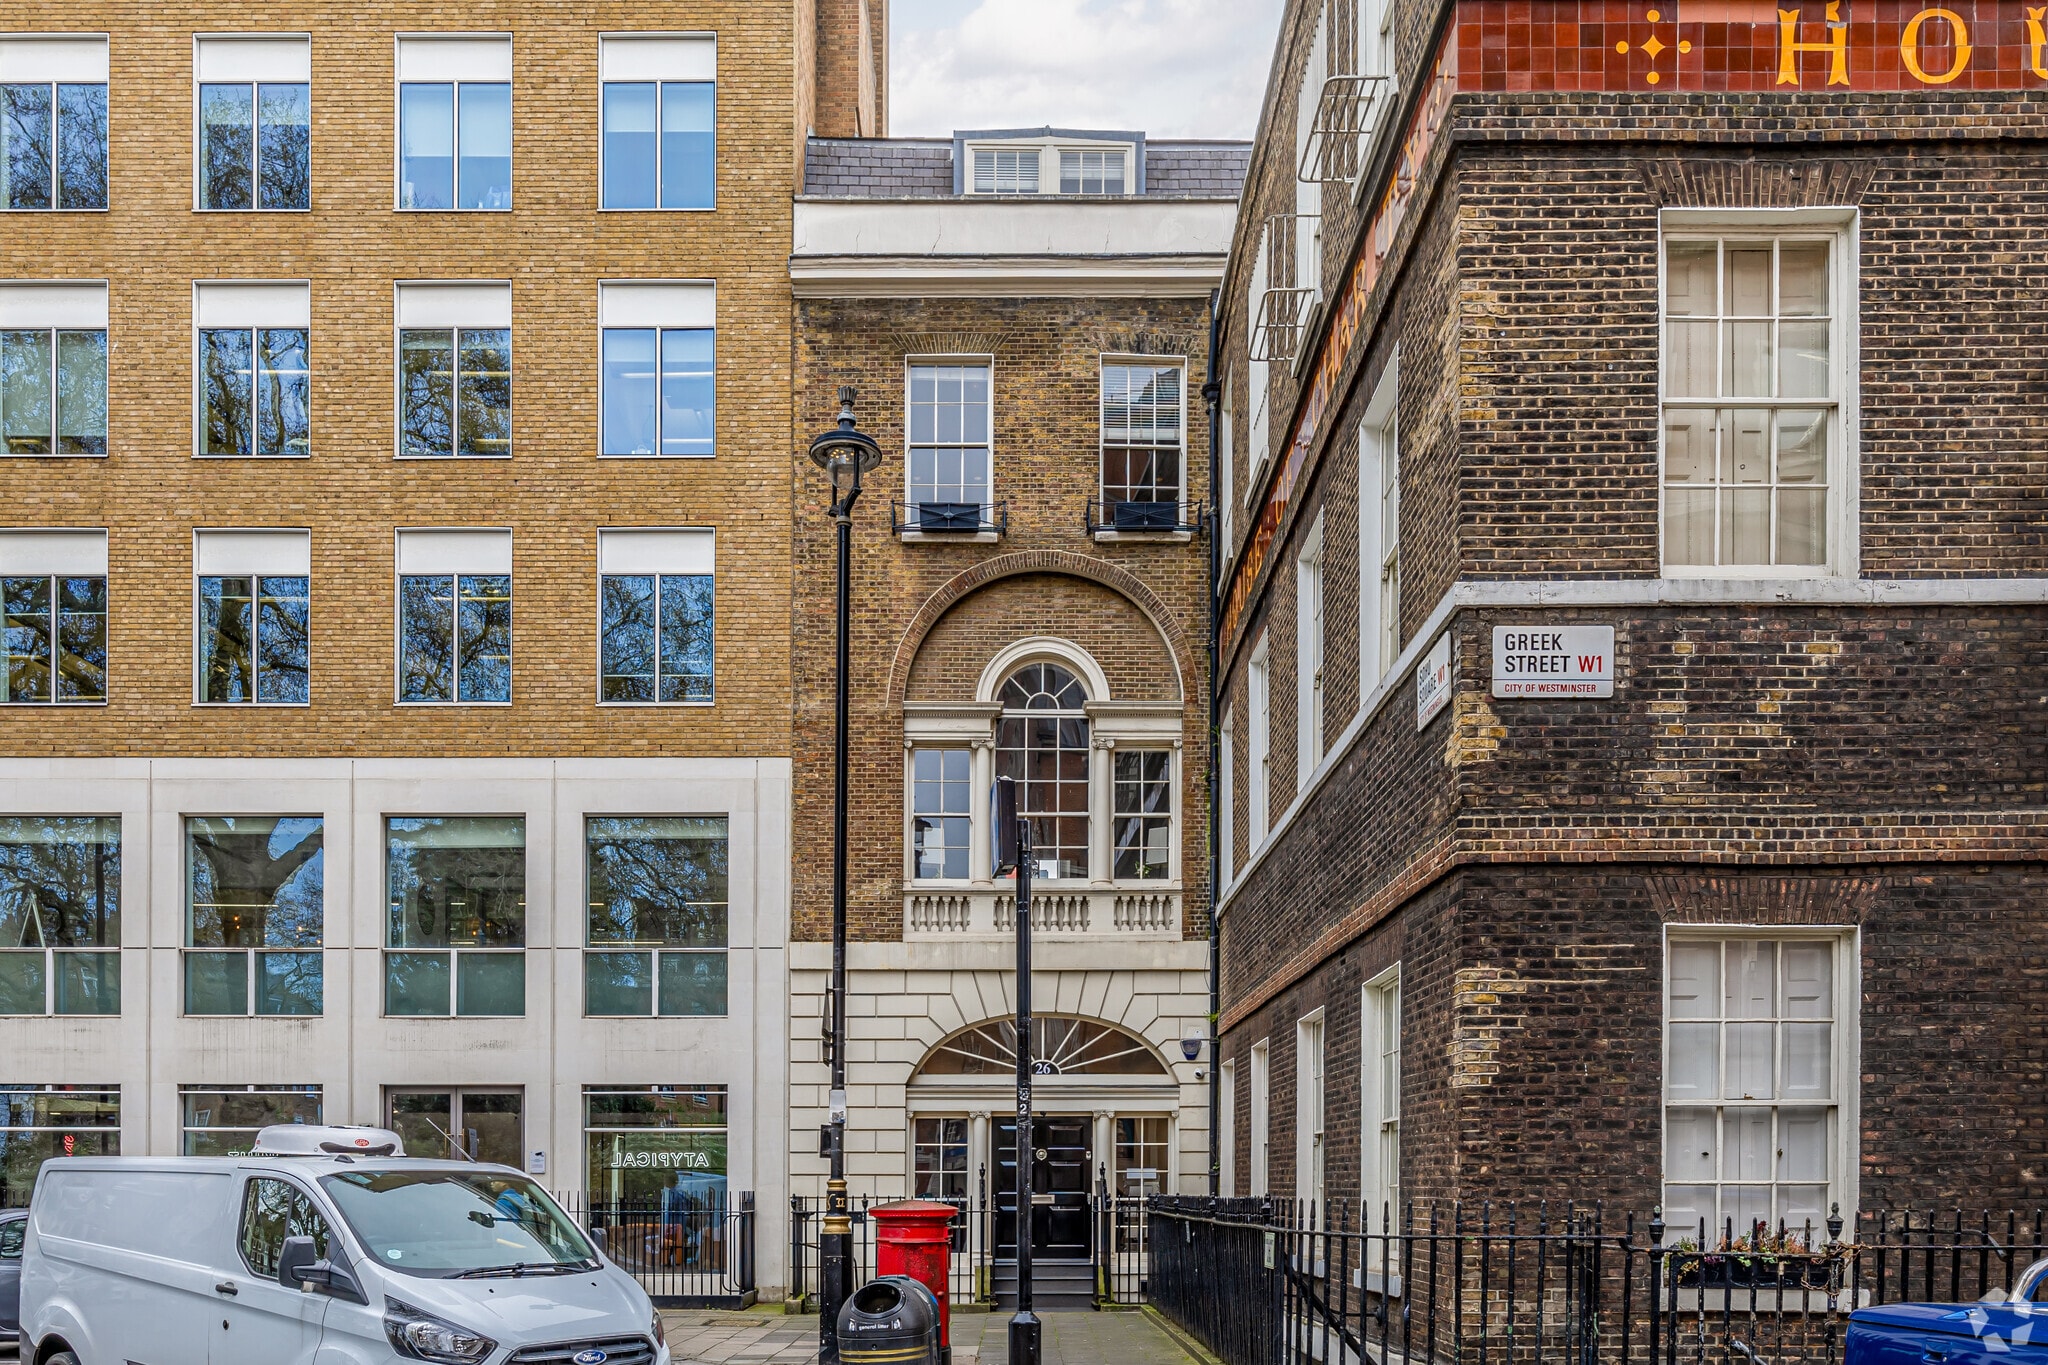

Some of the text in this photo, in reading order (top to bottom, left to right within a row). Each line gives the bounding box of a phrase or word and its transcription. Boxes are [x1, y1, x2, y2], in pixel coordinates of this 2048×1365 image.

[1276, 443, 1294, 525] OF
[1505, 633, 1563, 651] GREEK
[1505, 655, 1603, 673] STREET W1
[1504, 683, 1597, 693] CITY OF WESTMINSTER
[1035, 1063, 1051, 1074] 26
[858, 1323, 877, 1331] general
